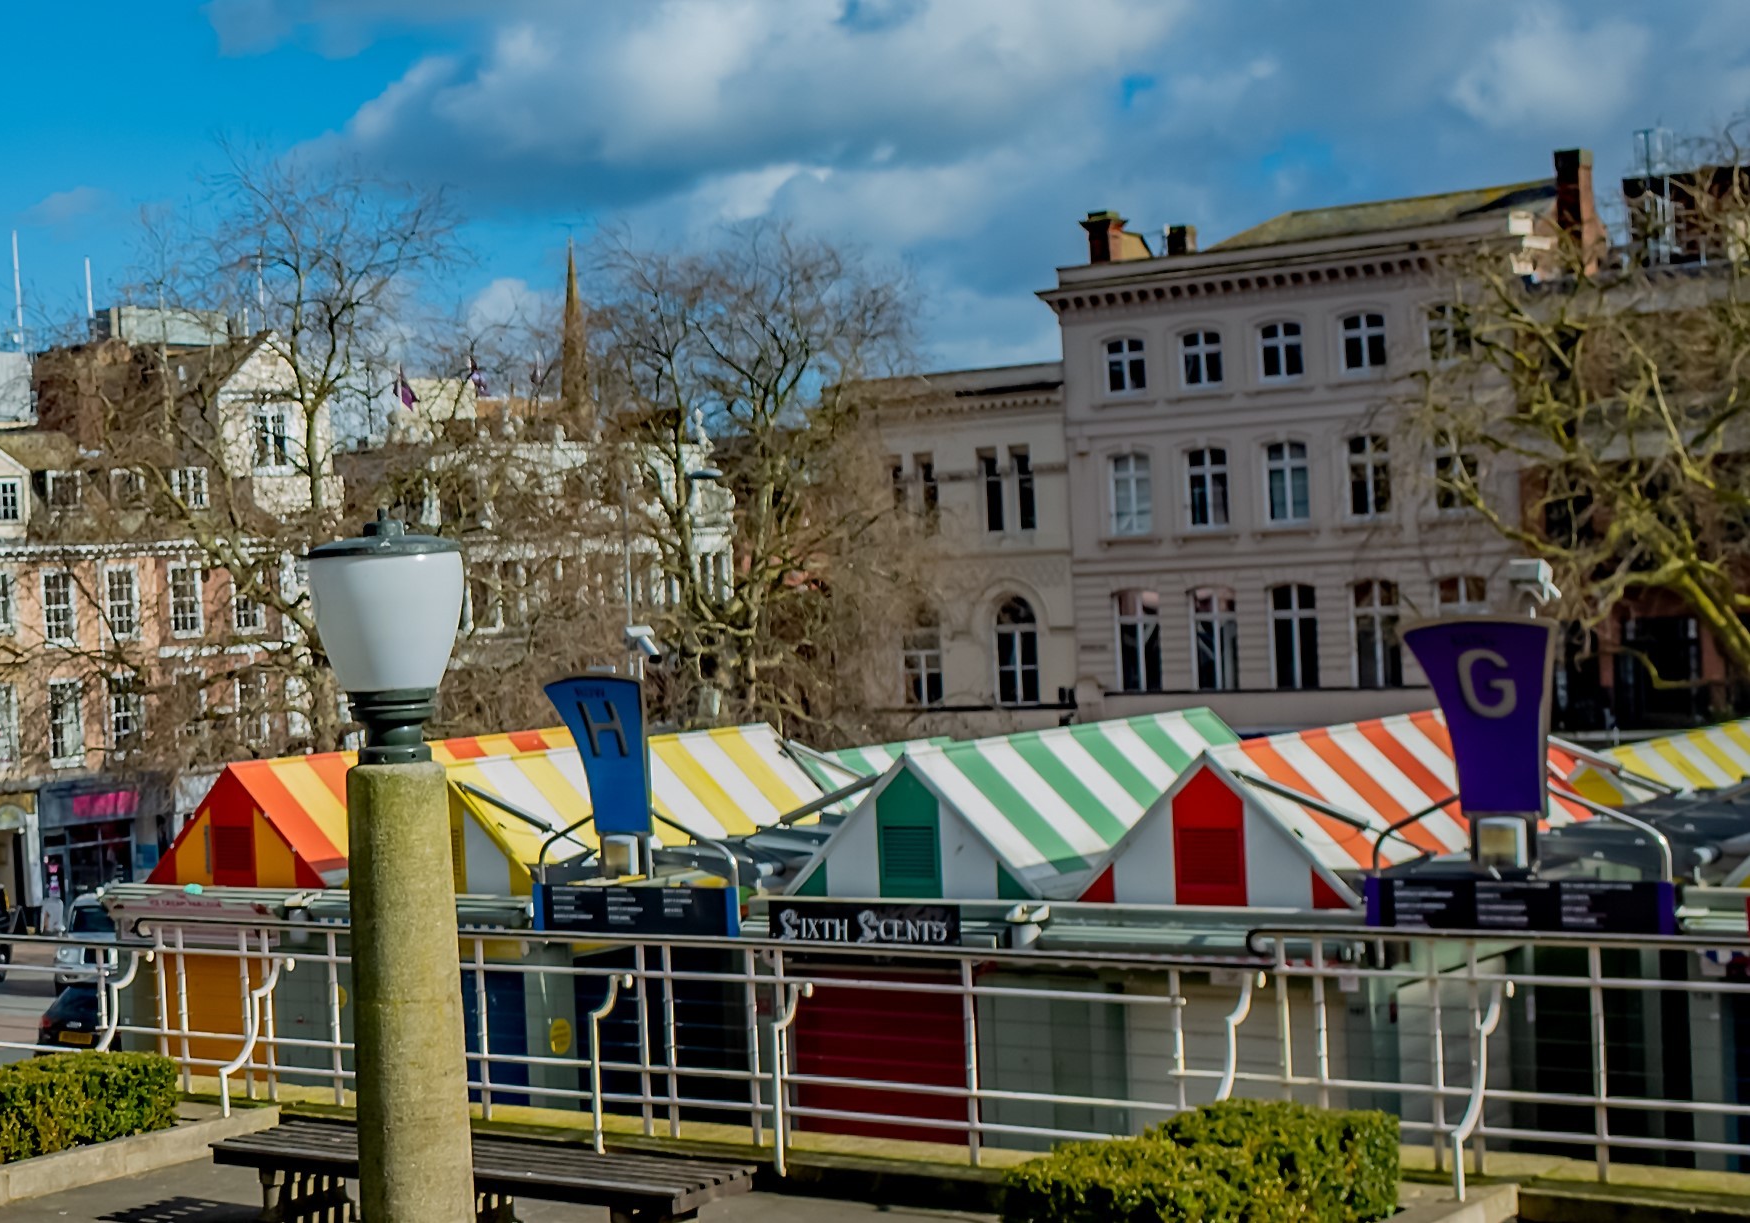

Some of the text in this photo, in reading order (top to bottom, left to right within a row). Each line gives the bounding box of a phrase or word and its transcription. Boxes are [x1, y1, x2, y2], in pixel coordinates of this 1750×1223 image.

[1457, 648, 1517, 719] G
[576, 701, 629, 758] H
[778, 908, 948, 943] SIXTH SCENTS
